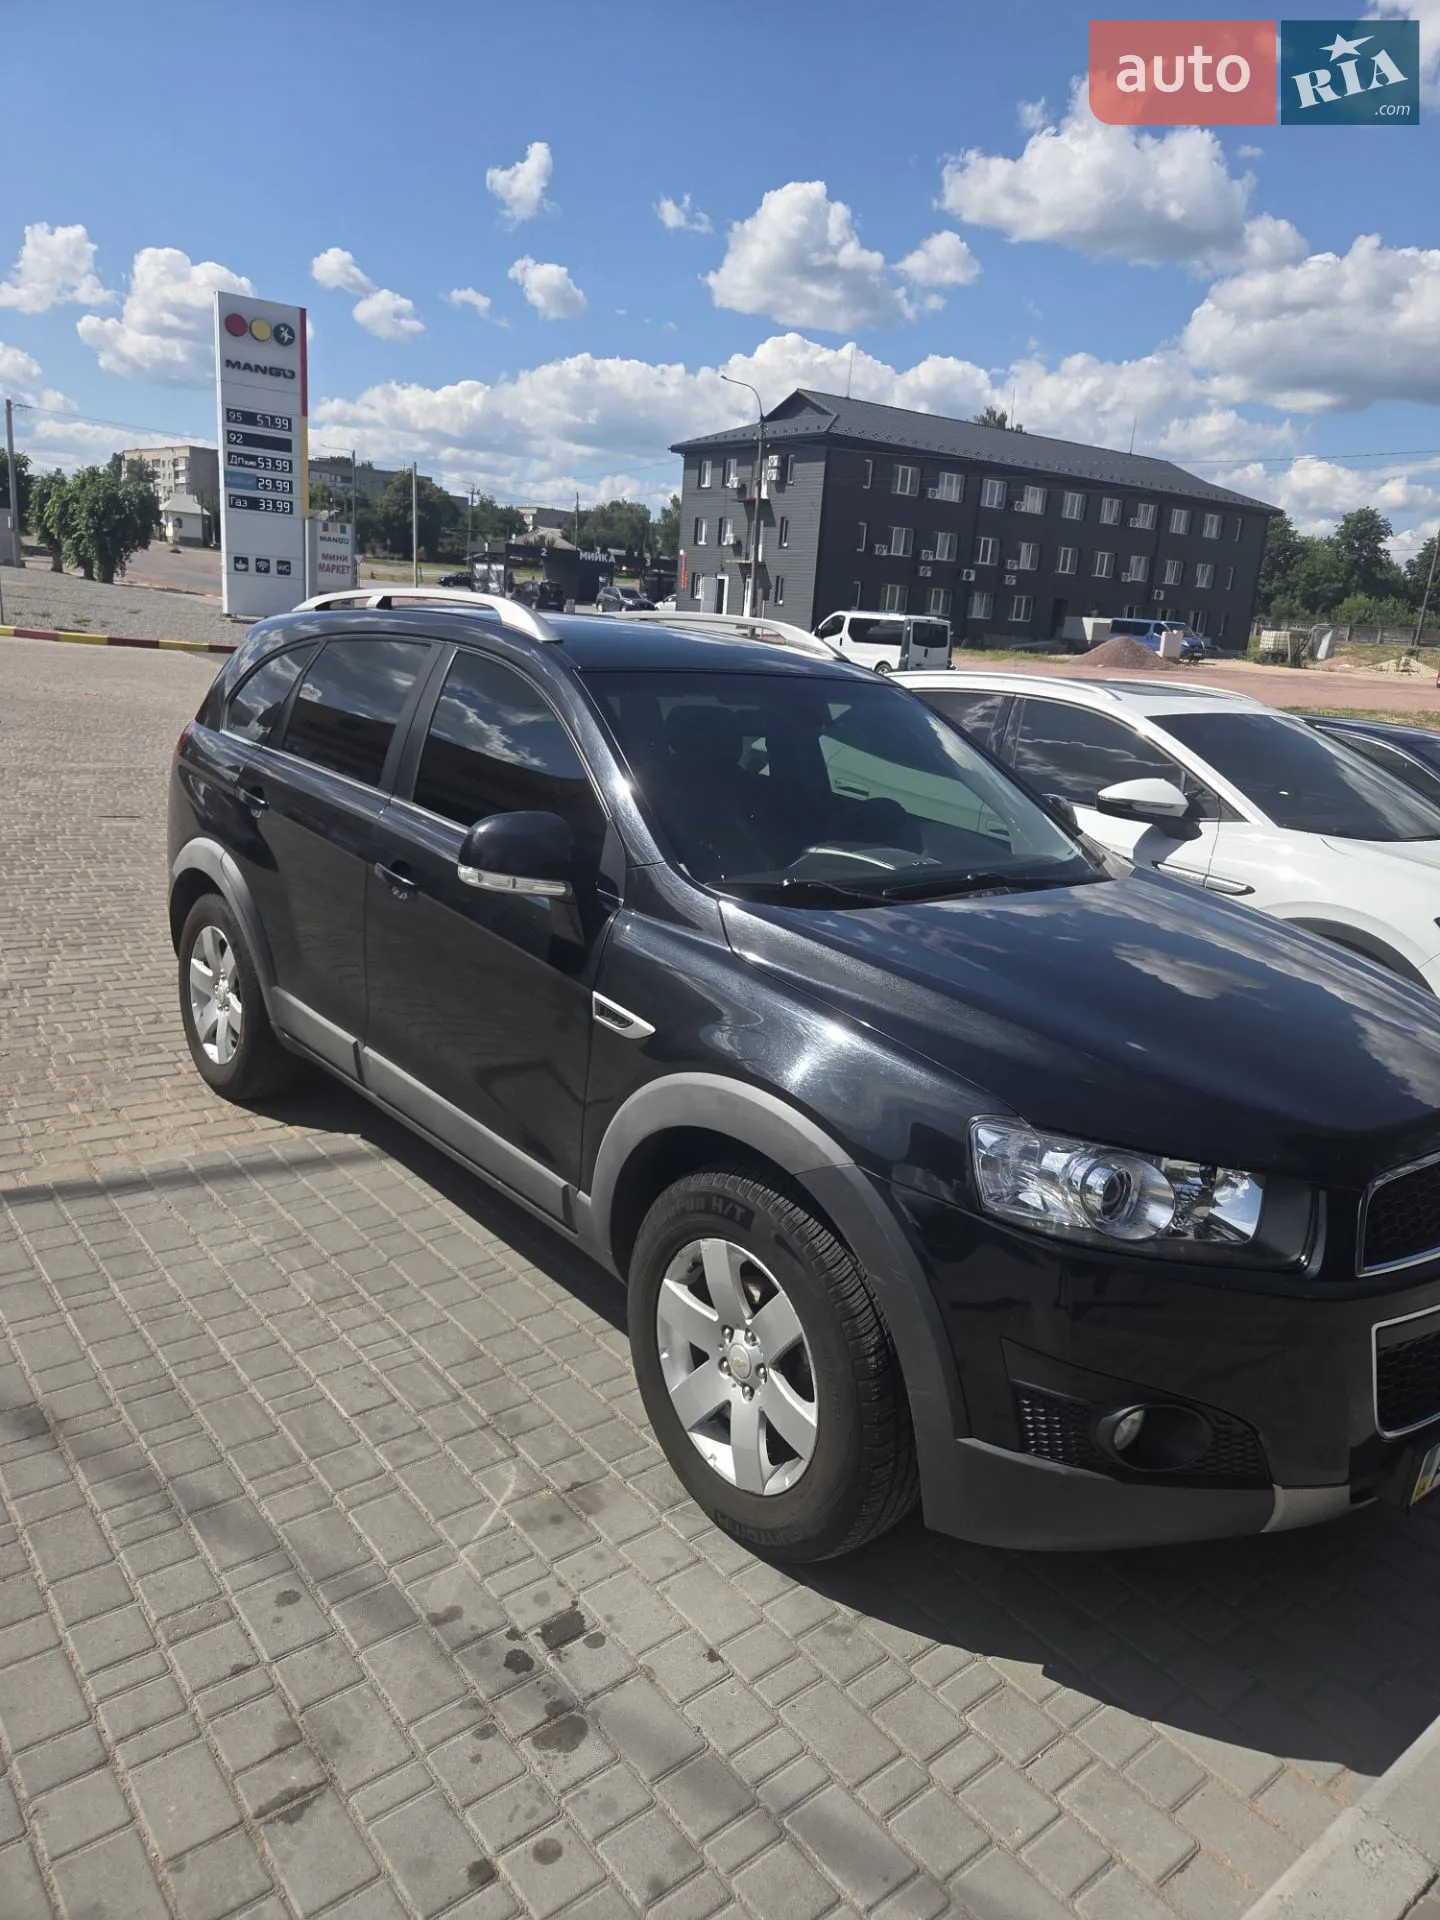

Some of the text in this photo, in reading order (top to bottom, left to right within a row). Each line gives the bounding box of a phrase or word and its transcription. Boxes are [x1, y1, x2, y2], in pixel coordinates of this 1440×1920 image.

[225, 359, 296, 380] MANGO
[228, 411, 289, 430] 95 57.99
[229, 432, 244, 444] 92
[257, 457, 290, 472] 53.99
[258, 478, 290, 493] 29.99
[230, 496, 290, 513] Газ 33.99
[319, 535, 350, 545] MANGO
[321, 553, 349, 561] МИНИ
[540, 547, 548, 557] 2
[579, 551, 616, 564] МИЙКА
[318, 563, 351, 575] МАРКЕТ
